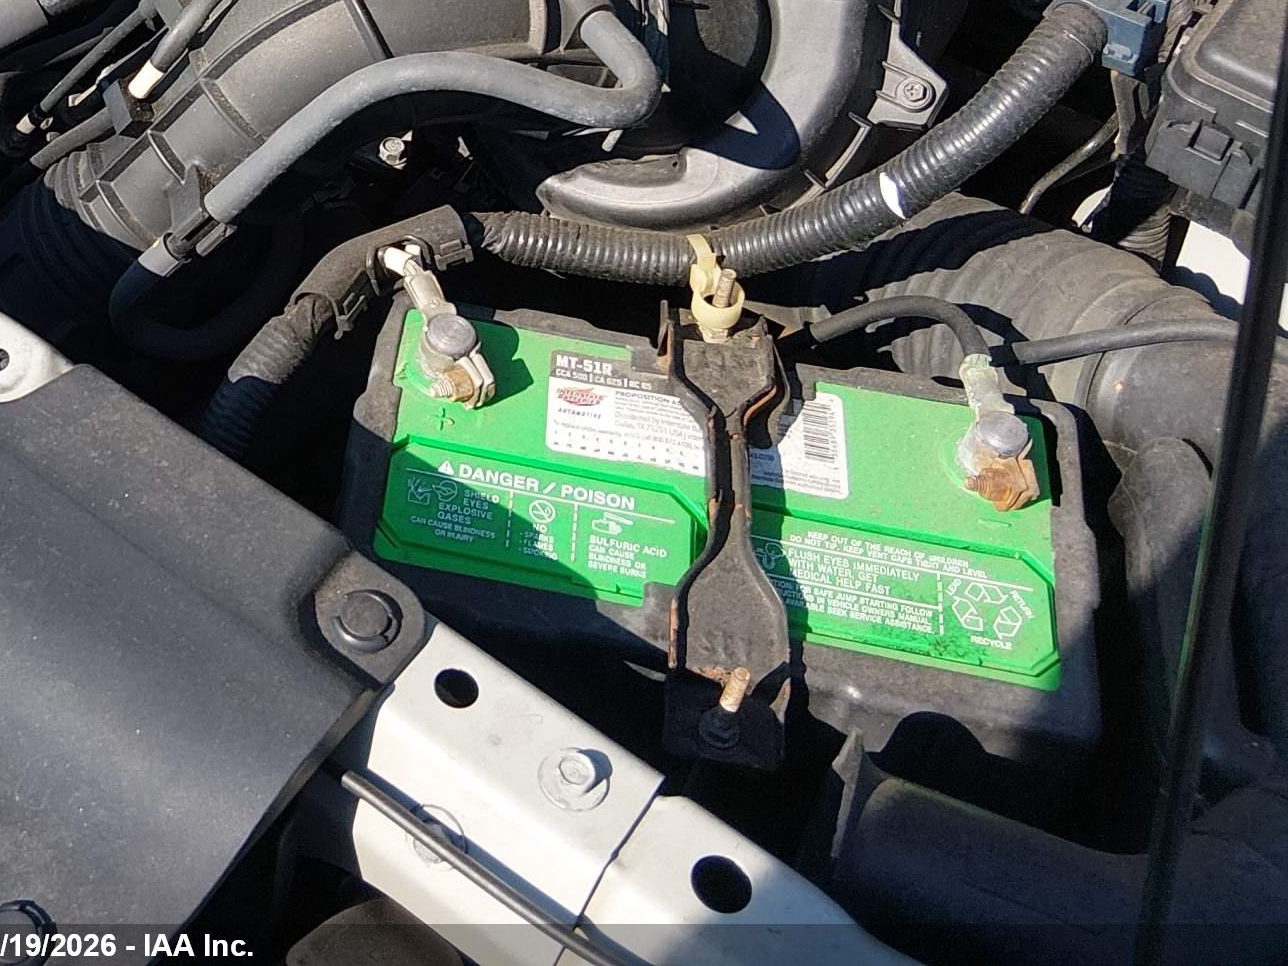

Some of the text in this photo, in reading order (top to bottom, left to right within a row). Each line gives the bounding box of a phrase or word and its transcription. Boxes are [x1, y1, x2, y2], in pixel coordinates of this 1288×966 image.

[556, 354, 612, 376] MT-51R
[556, 368, 572, 378] CCA
[594, 376, 605, 384] CA
[616, 390, 670, 404] PROPOSITION
[558, 408, 602, 419] AUTOMOTIVE
[460, 464, 636, 510] DANGER / POISON
[464, 490, 500, 504] SHIELD
[464, 498, 488, 510] EYES
[437, 512, 472, 525] GASES
[438, 502, 493, 520] EXPLOSIVE
[410, 516, 496, 538] CAN CAUSE BLINDNESS
[434, 528, 474, 543] OR INJURY
[532, 523, 548, 533] NO
[588, 534, 668, 558] SULFURIC ACID
[588, 544, 635, 560] CAN CAUSE
[790, 534, 802, 544] DO
[804, 538, 822, 547] NOT
[843, 545, 864, 555] KEEP
[867, 549, 889, 560] VENT
[890, 553, 912, 565] CAPS
[942, 564, 960, 574] AND
[808, 530, 828, 541] KEEP
[832, 536, 848, 545] OUT
[850, 538, 863, 548] OF
[864, 542, 882, 552] THE
[884, 545, 912, 558] REACH
[914, 550, 926, 560] OF
[588, 552, 646, 570] BLINDNESS OR
[588, 560, 647, 579] SEVERE BURNS
[788, 548, 920, 582] FLUSH EYES IMMEDIATELY
[790, 558, 817, 570] WITH
[858, 571, 878, 584] GET
[792, 569, 891, 596] MEDICAL HELP FAST
[945, 578, 962, 596] LEAD
[796, 584, 813, 594] FOR
[814, 587, 836, 599] SAFE
[838, 592, 858, 602] JUMP
[860, 596, 898, 611] STARTING
[900, 604, 933, 618] FOLLOW
[816, 595, 826, 604] IN
[827, 598, 860, 612] VEHICLE
[1010, 590, 1036, 619] RETURN
[826, 606, 848, 618] SEEK
[849, 610, 882, 624] SERVICE
[970, 635, 1013, 650] RECYCLE
